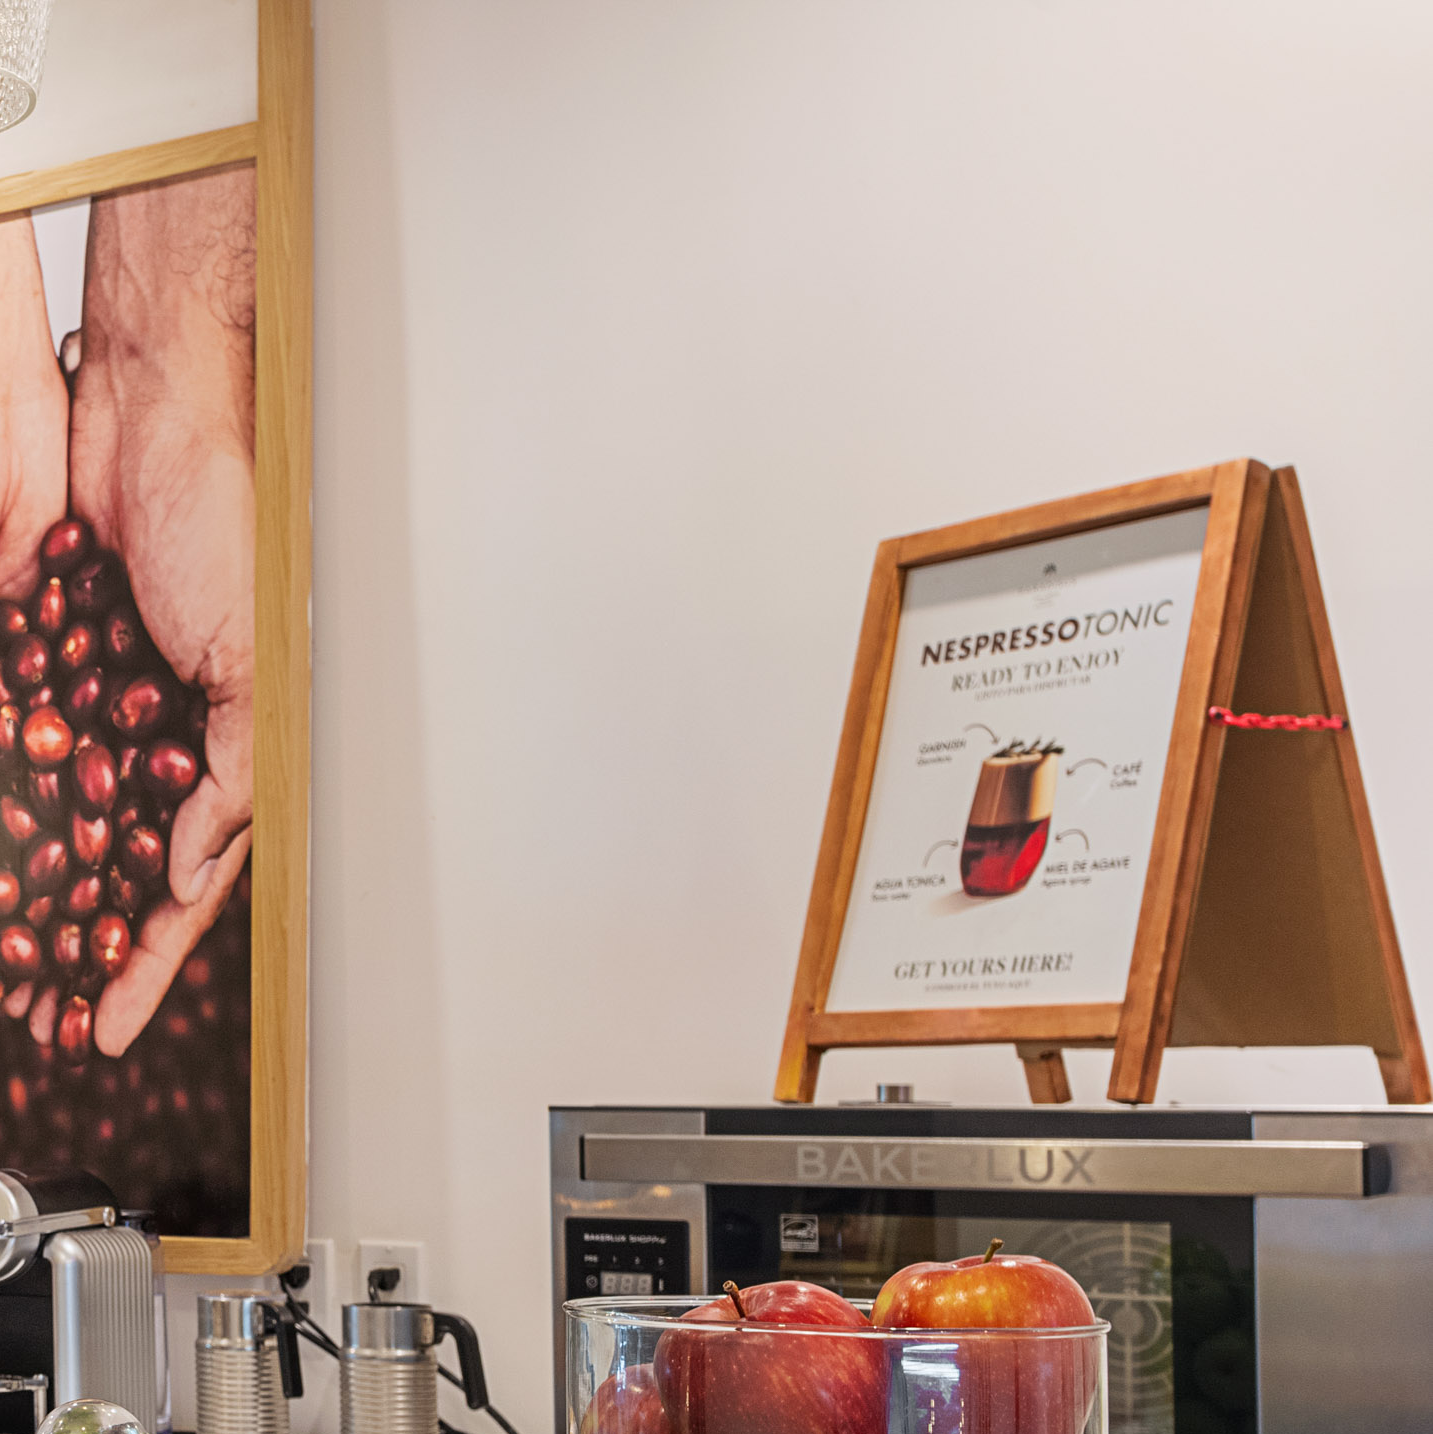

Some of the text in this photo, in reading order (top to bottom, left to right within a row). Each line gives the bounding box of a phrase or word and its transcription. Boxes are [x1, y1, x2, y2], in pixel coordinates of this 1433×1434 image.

[951, 648, 1124, 693] READY TO ENJOY
[894, 959, 936, 981] GET
[941, 956, 1008, 978] YOURS
[796, 1145, 1095, 1185] BAKELUX
